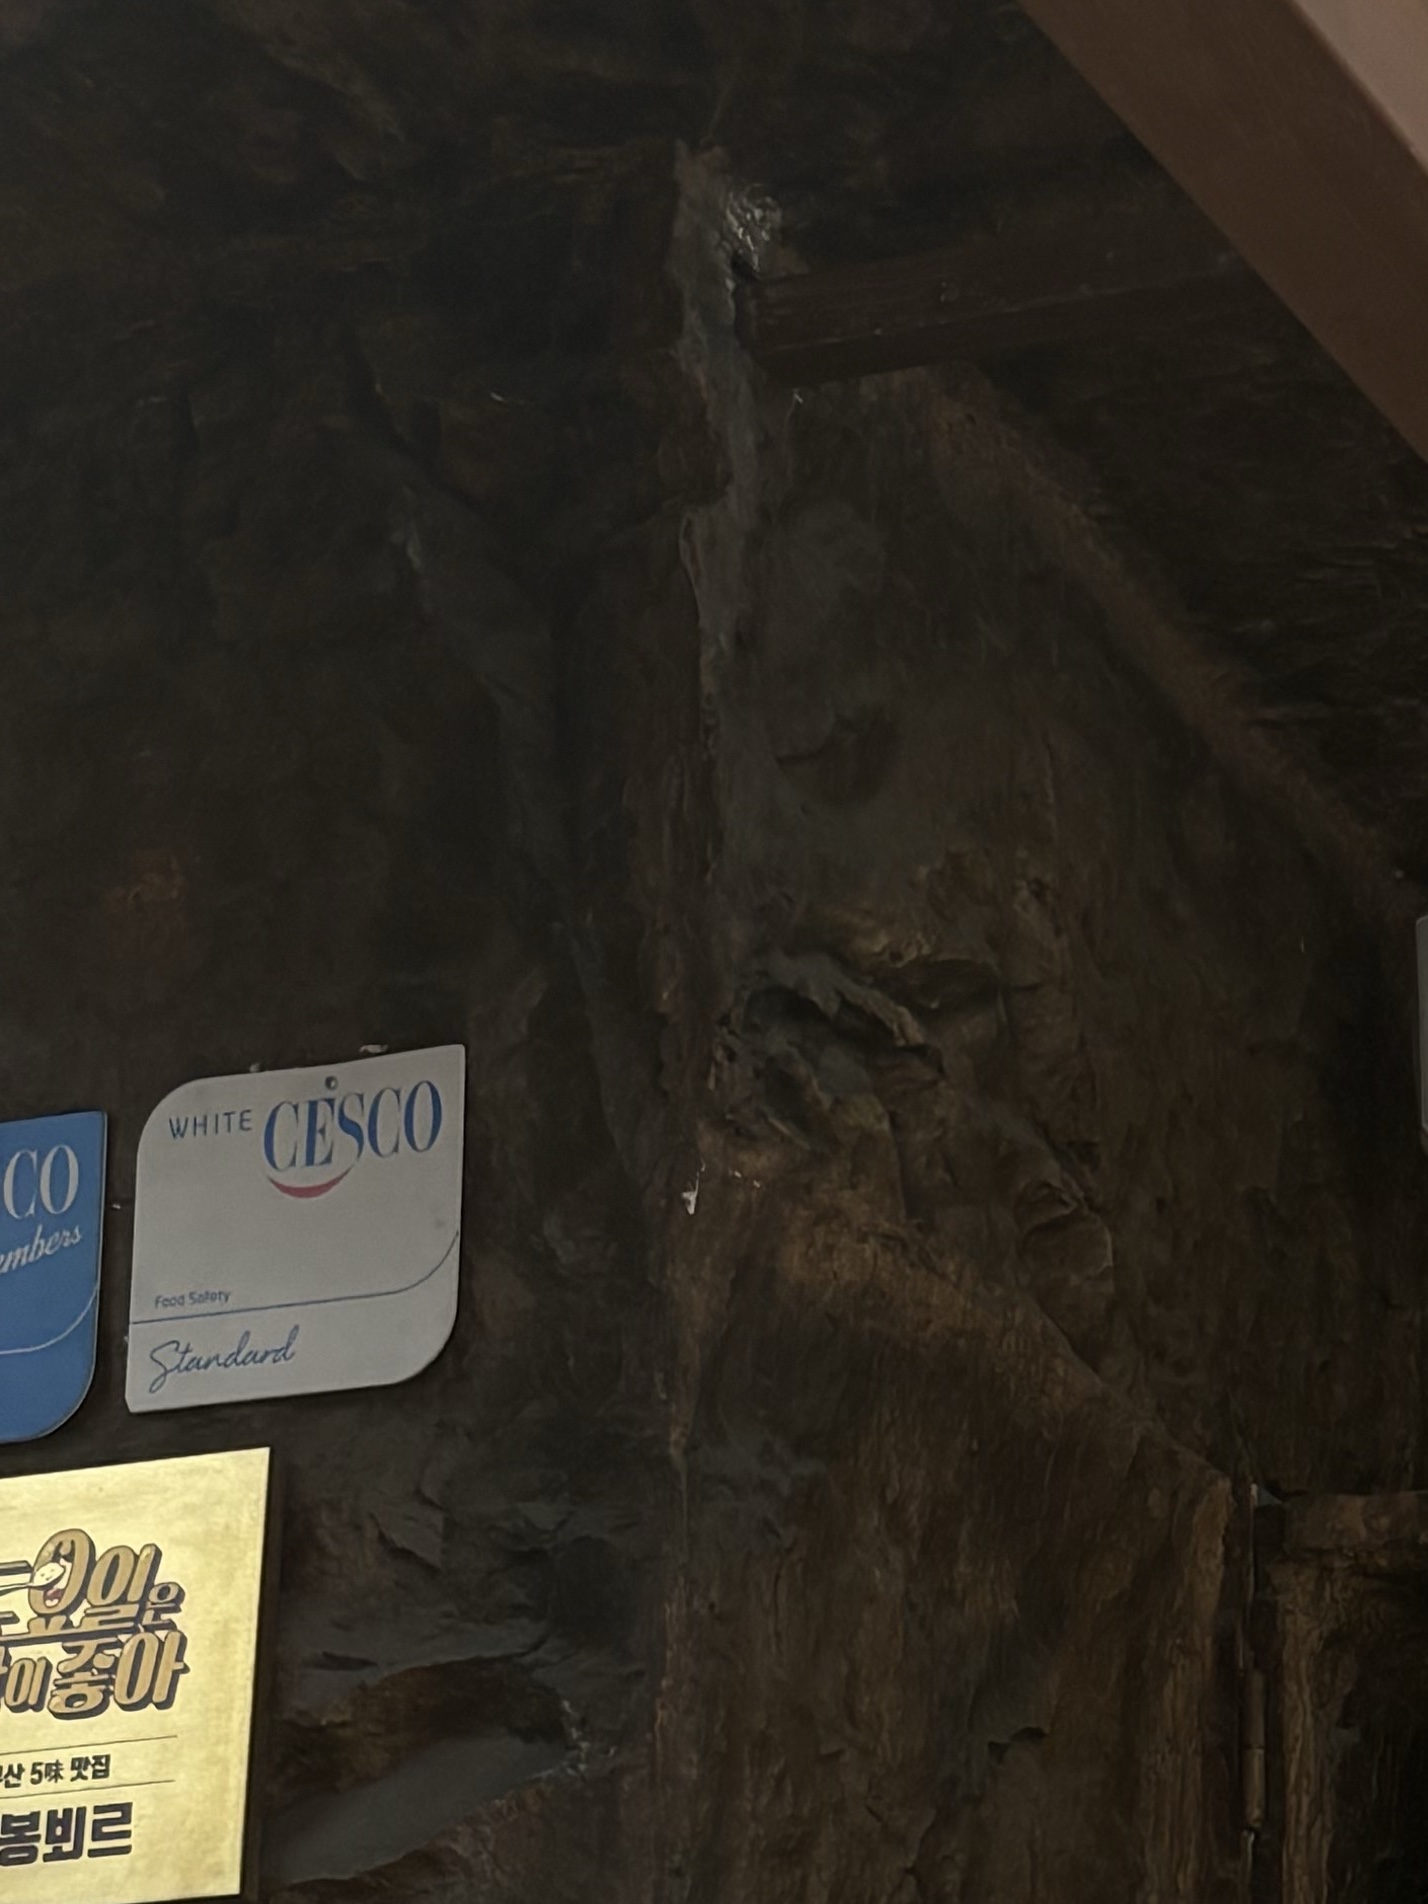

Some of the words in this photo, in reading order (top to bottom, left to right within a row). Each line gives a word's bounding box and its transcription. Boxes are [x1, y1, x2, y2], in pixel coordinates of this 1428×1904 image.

[169, 1109, 253, 1141] WHITE
[263, 1079, 443, 1174] CESCO
[149, 1324, 300, 1394] Standard
[0, 1655, 52, 1713] 이
[0, 1763, 25, 1789] 산
[70, 1754, 111, 1782] 맛집
